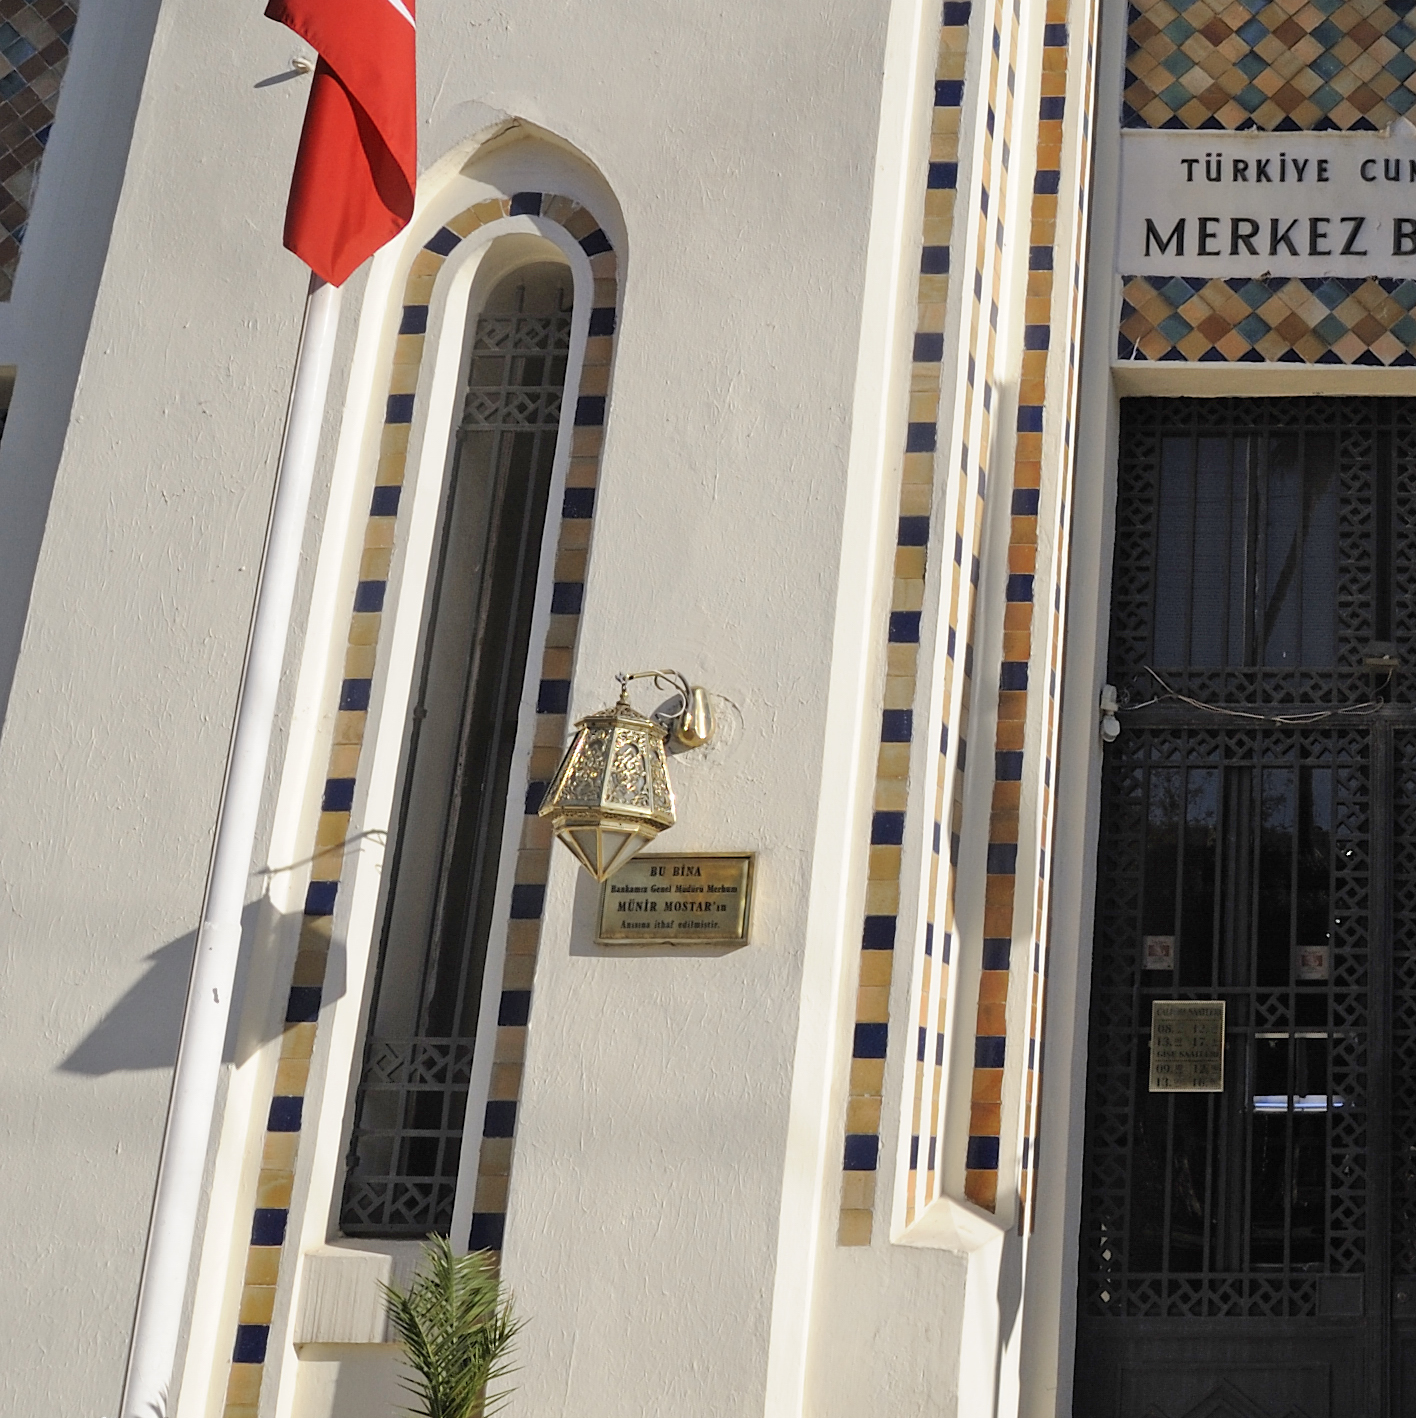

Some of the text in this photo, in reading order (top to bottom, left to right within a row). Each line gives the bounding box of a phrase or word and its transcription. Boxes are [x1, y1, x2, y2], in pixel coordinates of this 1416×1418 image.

[1180, 152, 1330, 183] TÜRKİYE
[1143, 217, 1368, 257] MERKEZ
[649, 864, 702, 877] BU BİNA
[650, 885, 672, 894] Genel
[616, 898, 658, 912] MÜNİR
